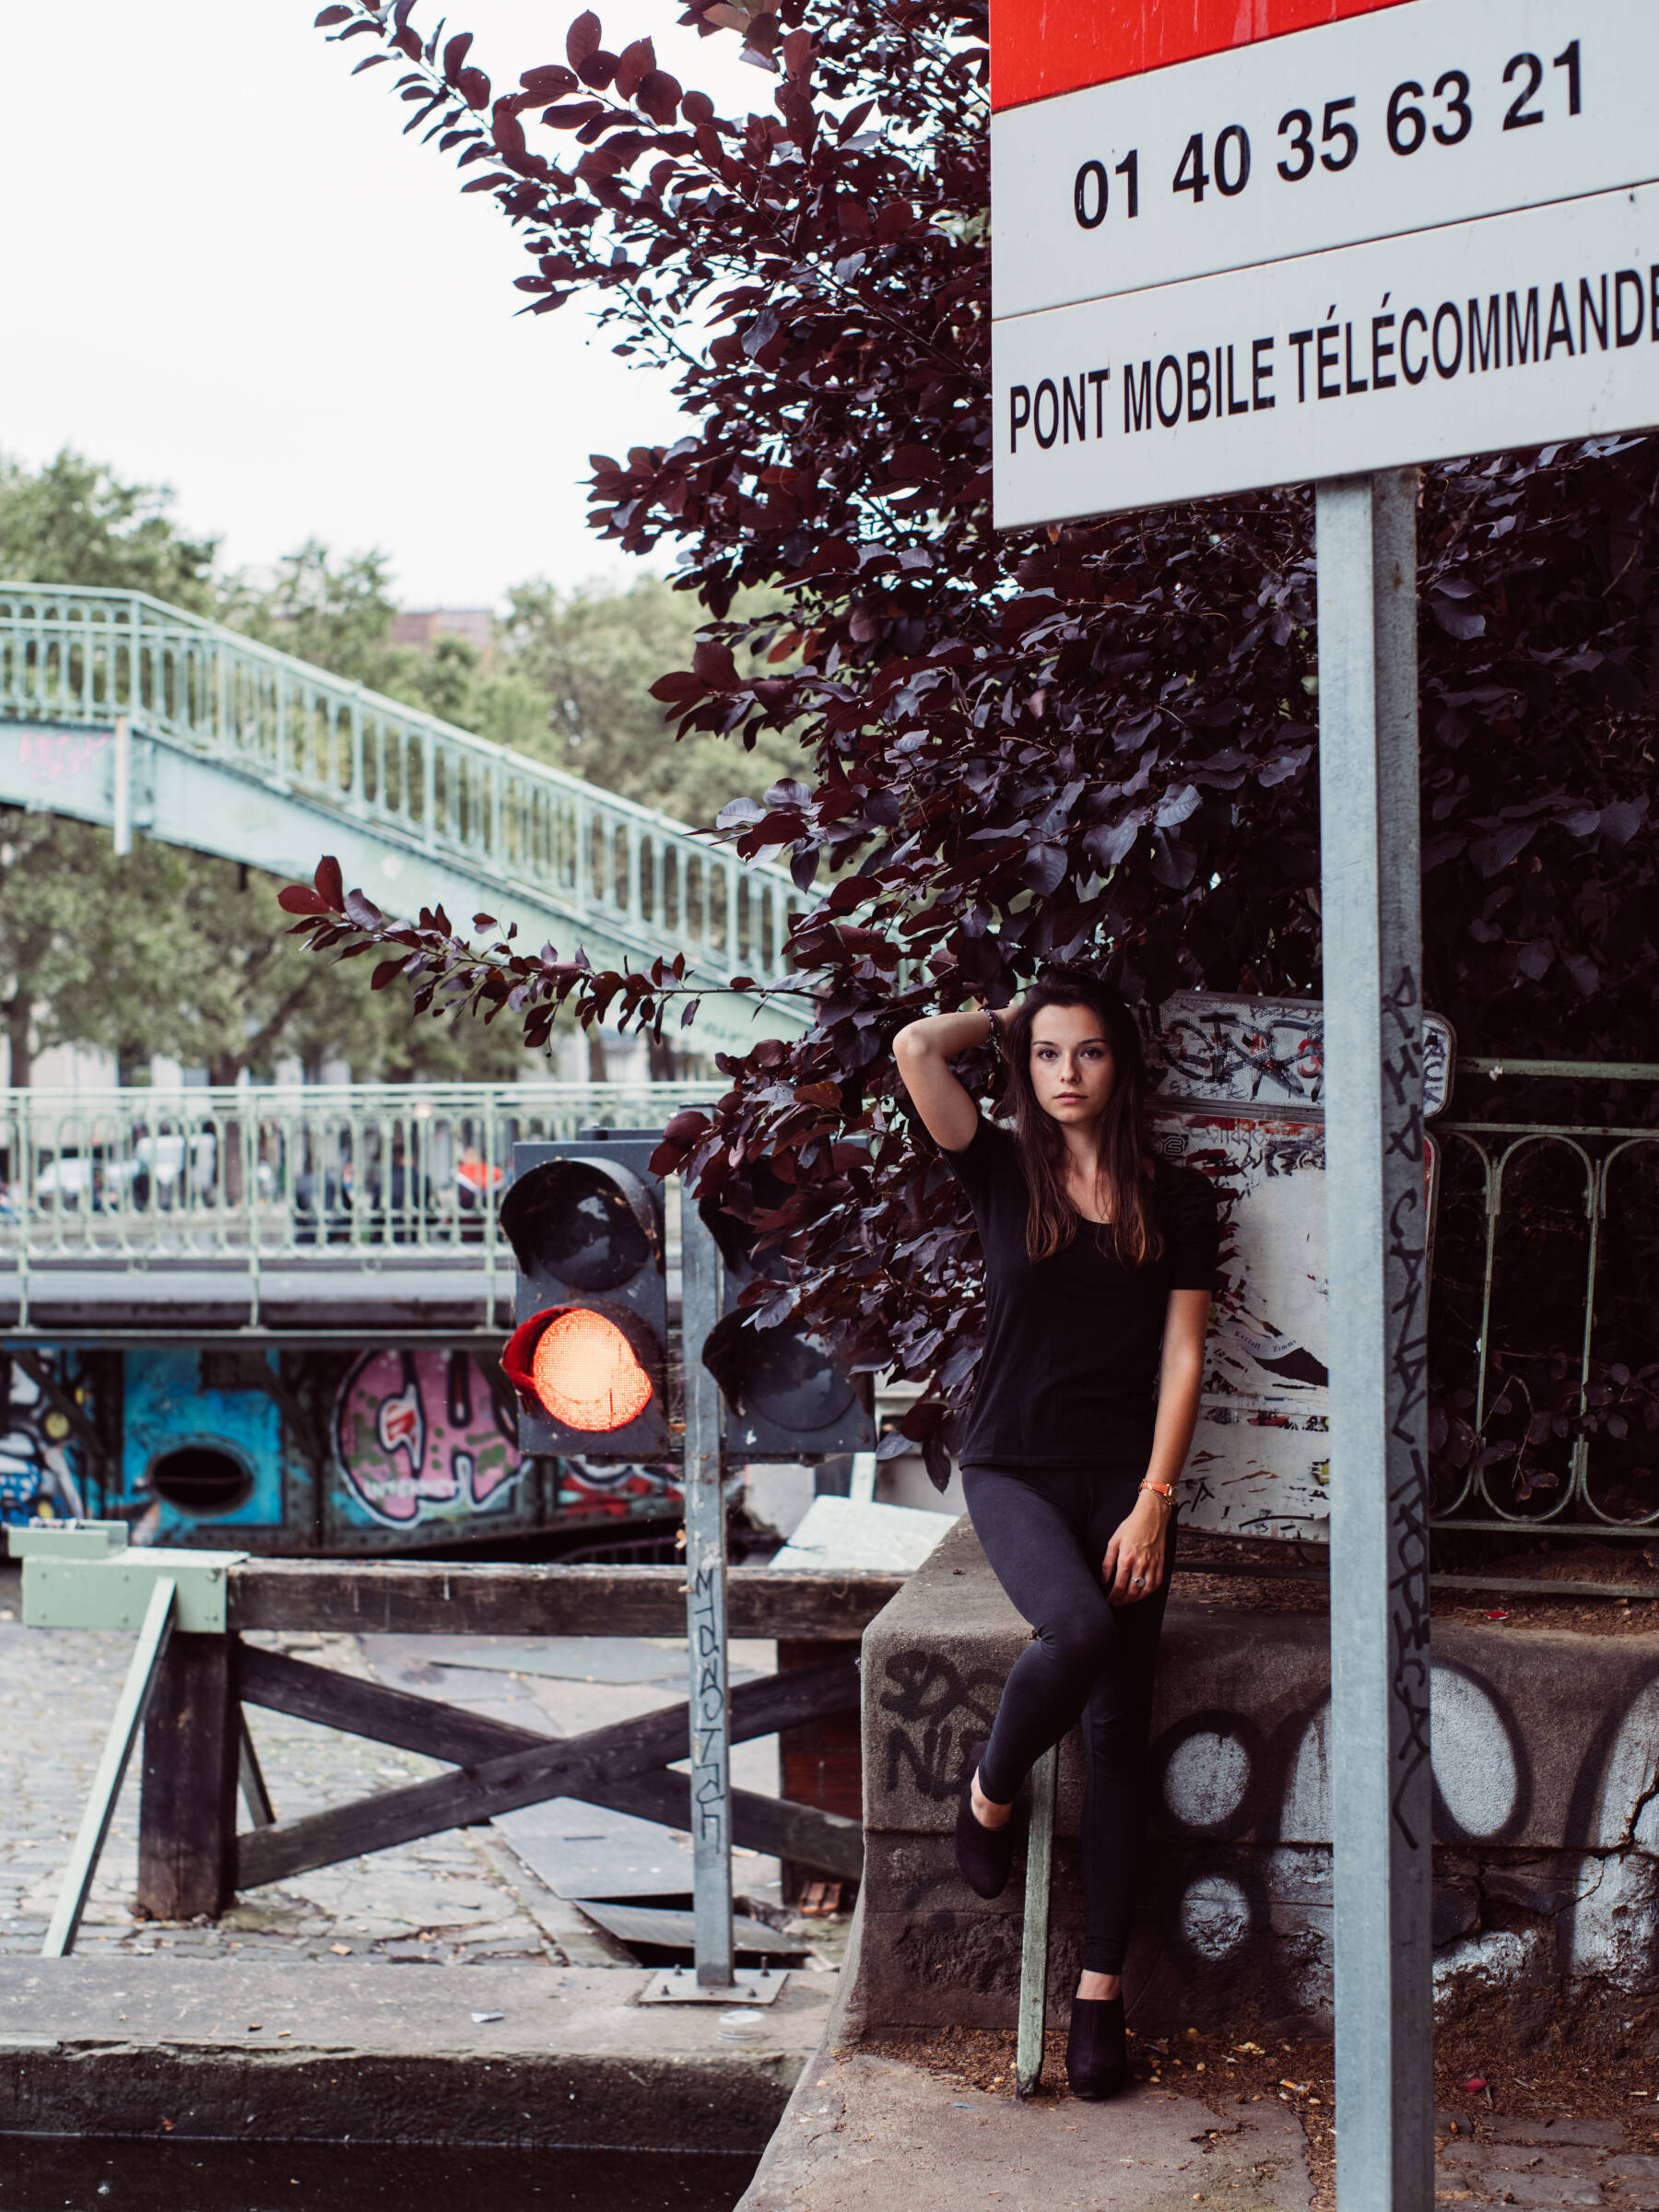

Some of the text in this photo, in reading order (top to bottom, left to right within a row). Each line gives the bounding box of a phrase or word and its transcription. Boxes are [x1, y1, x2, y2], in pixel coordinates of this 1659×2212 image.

[1074, 39, 1582, 230] 01 40 35 63 21
[1009, 367, 1111, 454] PONT
[1124, 336, 1276, 434] MOBILE
